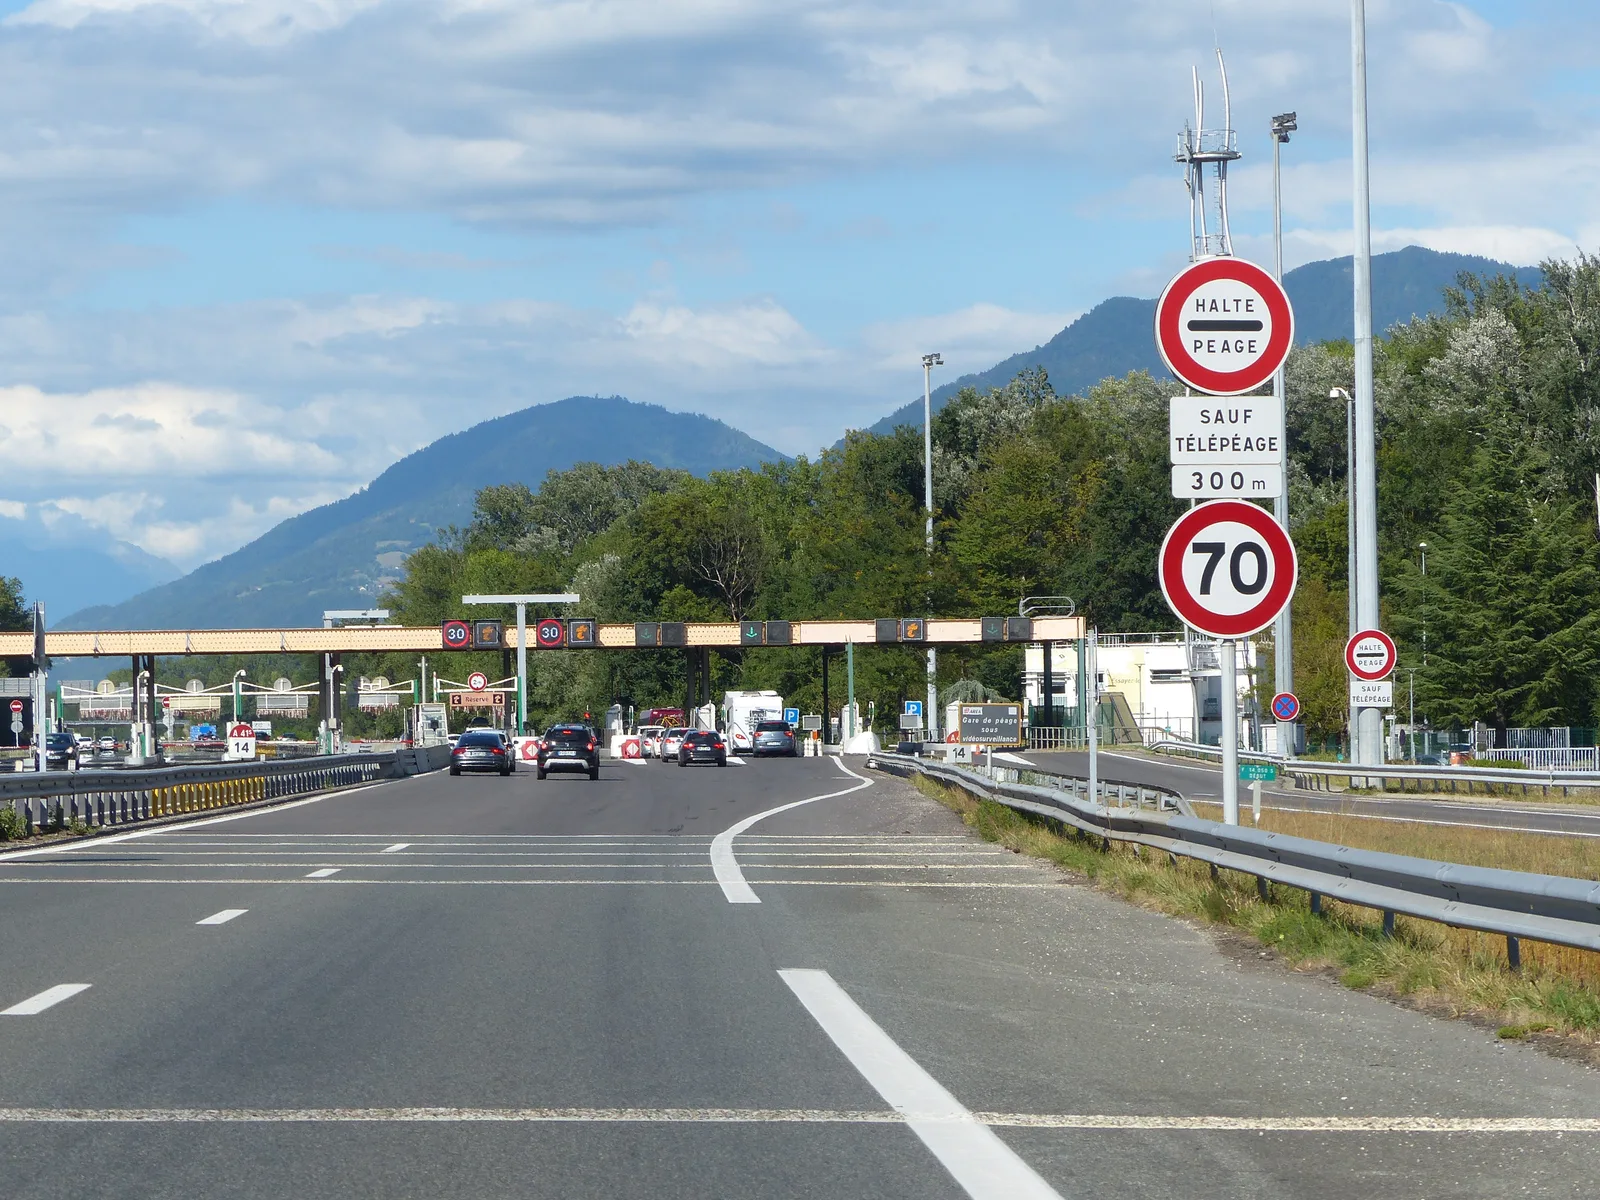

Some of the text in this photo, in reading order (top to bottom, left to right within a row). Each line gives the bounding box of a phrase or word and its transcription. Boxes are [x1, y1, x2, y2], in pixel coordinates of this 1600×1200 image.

[1195, 298, 1255, 313] HALTE
[1193, 339, 1257, 354] PEAGE
[1200, 409, 1253, 424] SAUF
[1175, 433, 1278, 452] TÉLÉPÉAGE
[1191, 471, 1266, 490] 300 m
[1192, 541, 1268, 595] 70
[448, 628, 465, 640] 30
[541, 627, 558, 639] 30
[1352, 695, 1391, 703] TÉLÉPÉAGE
[788, 711, 795, 721] P
[995, 717, 1018, 725] péage
[235, 742, 249, 753] 14
[953, 748, 966, 758] 14
